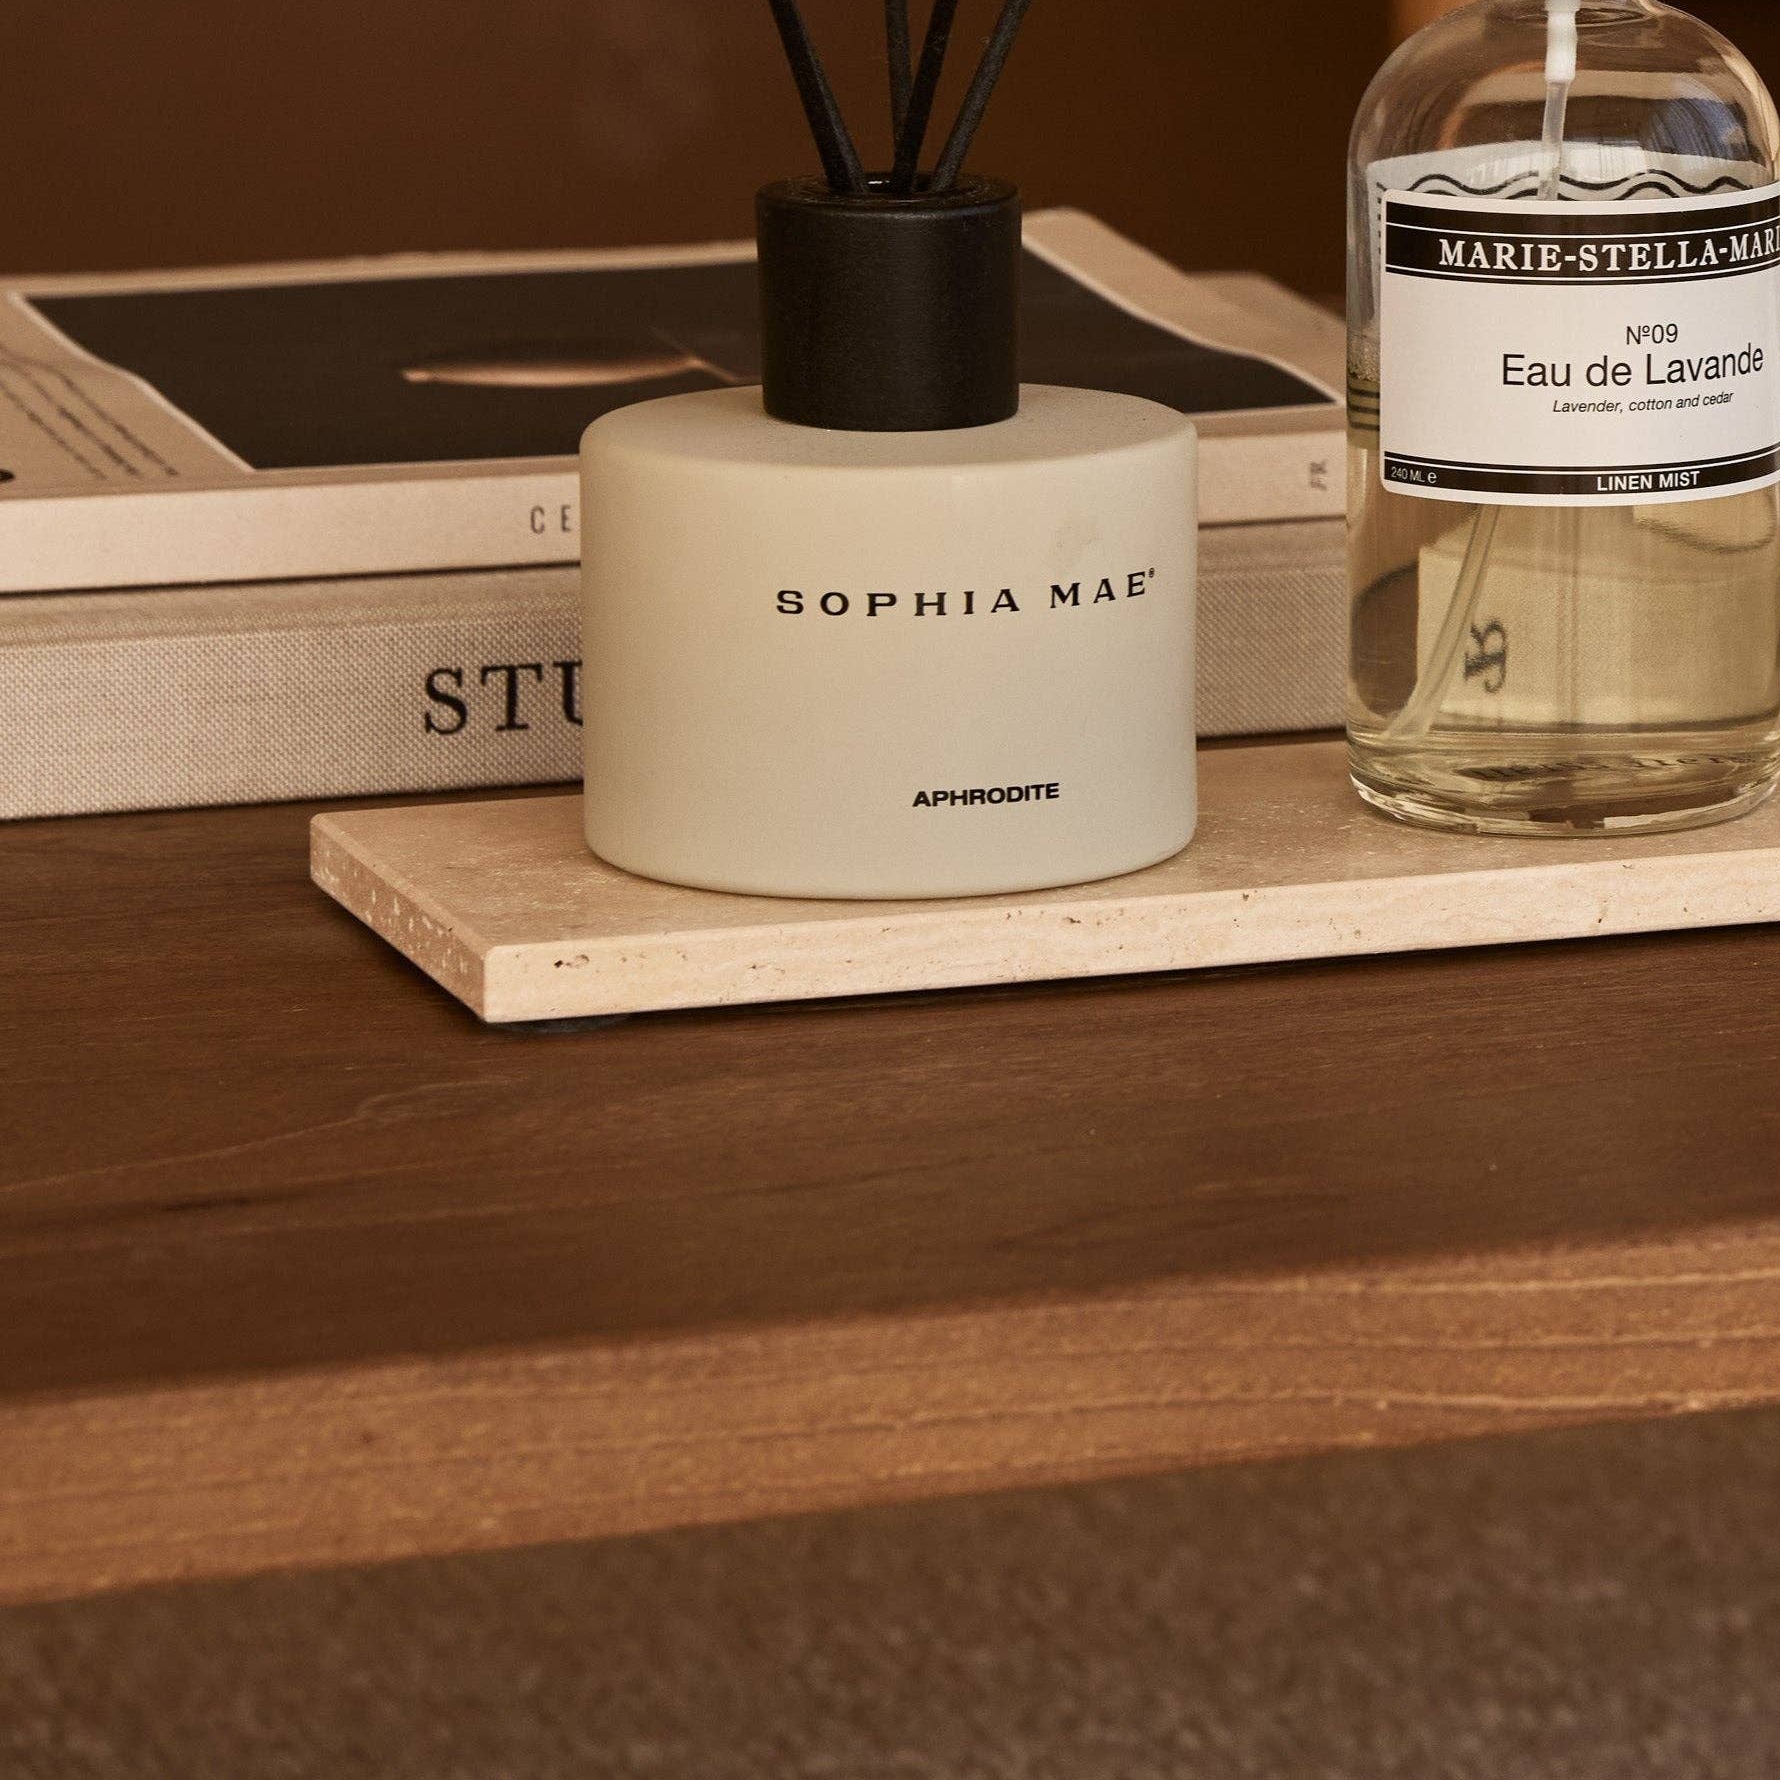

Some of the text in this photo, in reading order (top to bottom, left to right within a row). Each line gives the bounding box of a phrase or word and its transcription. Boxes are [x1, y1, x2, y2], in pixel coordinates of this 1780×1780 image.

[1502, 342, 1764, 387] Eau de Lavande
[1552, 390, 1735, 414] Lavender, cotton and cedar
[1391, 466, 1409, 481] 240
[1597, 470, 1701, 492] LINEN MIST
[776, 588, 1021, 617] SOPHIA
[912, 782, 1060, 807] APHRODITE
